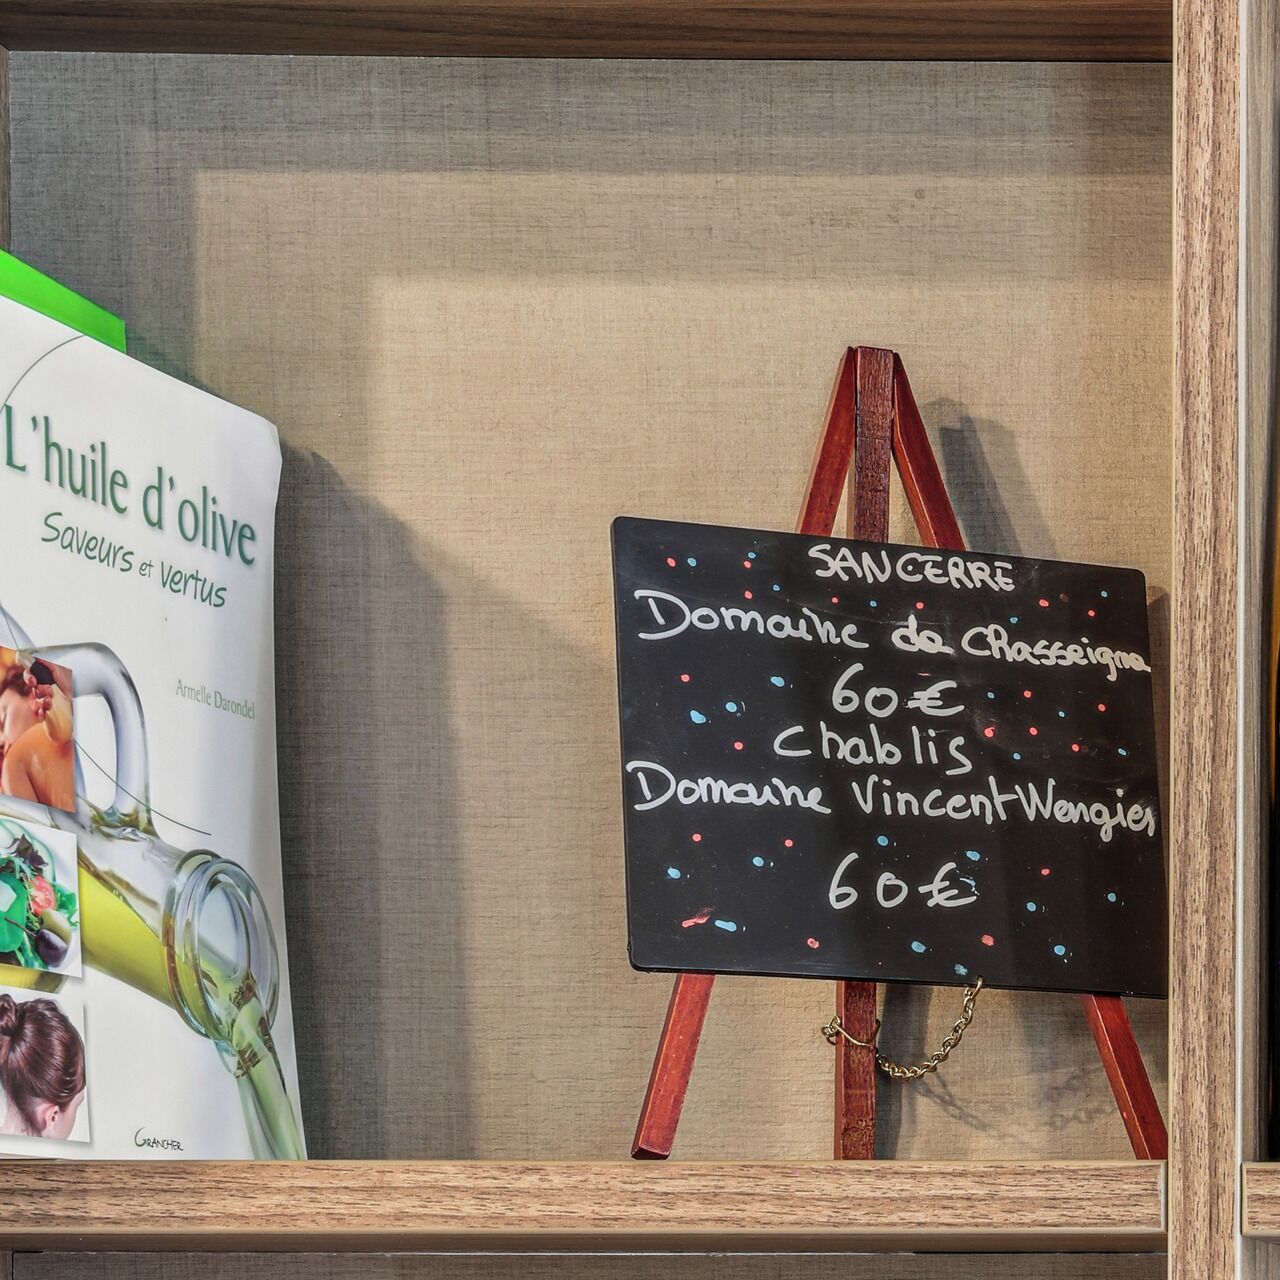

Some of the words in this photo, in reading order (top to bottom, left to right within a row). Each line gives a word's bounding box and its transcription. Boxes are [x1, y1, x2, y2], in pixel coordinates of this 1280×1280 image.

[4, 405, 128, 515] L'huile
[143, 466, 256, 566] d'olive
[41, 512, 133, 572] Saveurs
[139, 559, 154, 578] et
[161, 561, 227, 608] vertus
[808, 544, 1015, 592] SANCERRE
[634, 590, 869, 648] Domaine
[176, 679, 211, 707] Armelle
[214, 691, 255, 720] Darondel
[773, 723, 972, 776] Chablis
[626, 761, 831, 814] Domaine
[852, 776, 1017, 824] Vincent
